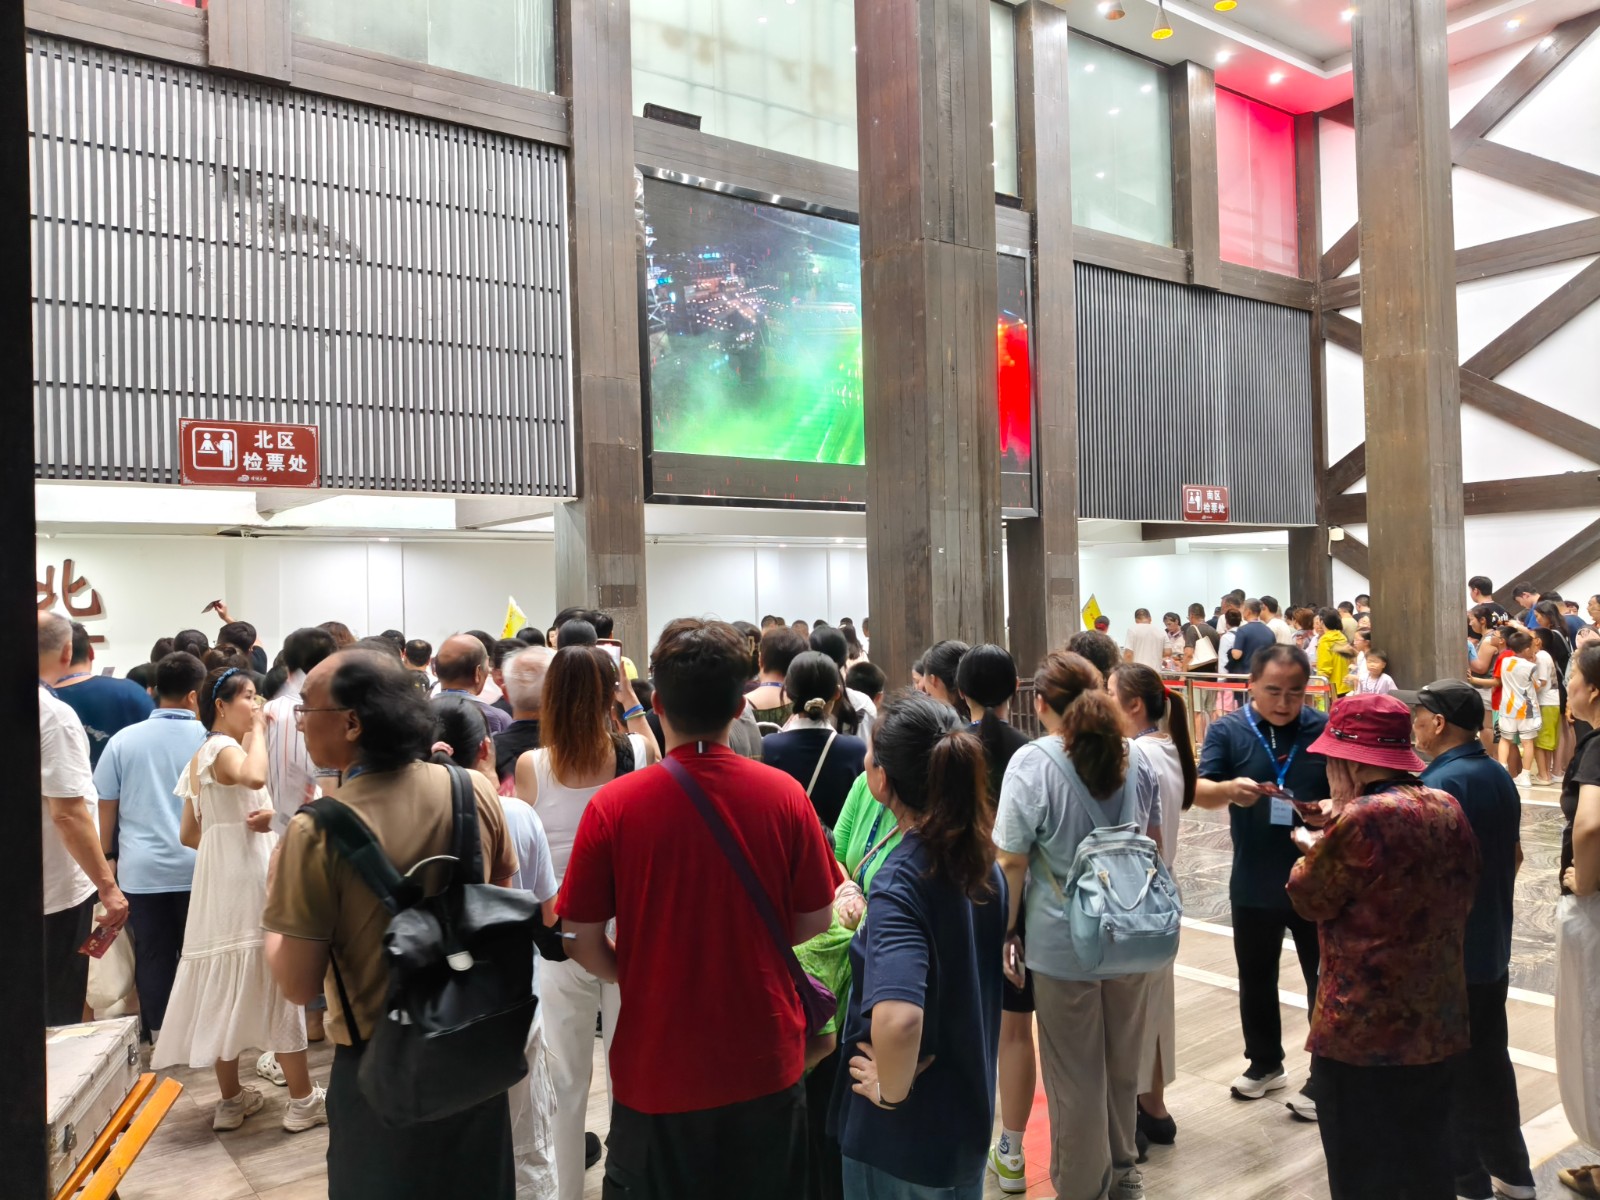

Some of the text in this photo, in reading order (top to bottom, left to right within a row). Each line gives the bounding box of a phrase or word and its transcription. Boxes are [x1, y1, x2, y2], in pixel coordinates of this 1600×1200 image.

[254, 429, 295, 449] 北区
[243, 451, 308, 472] 检票处
